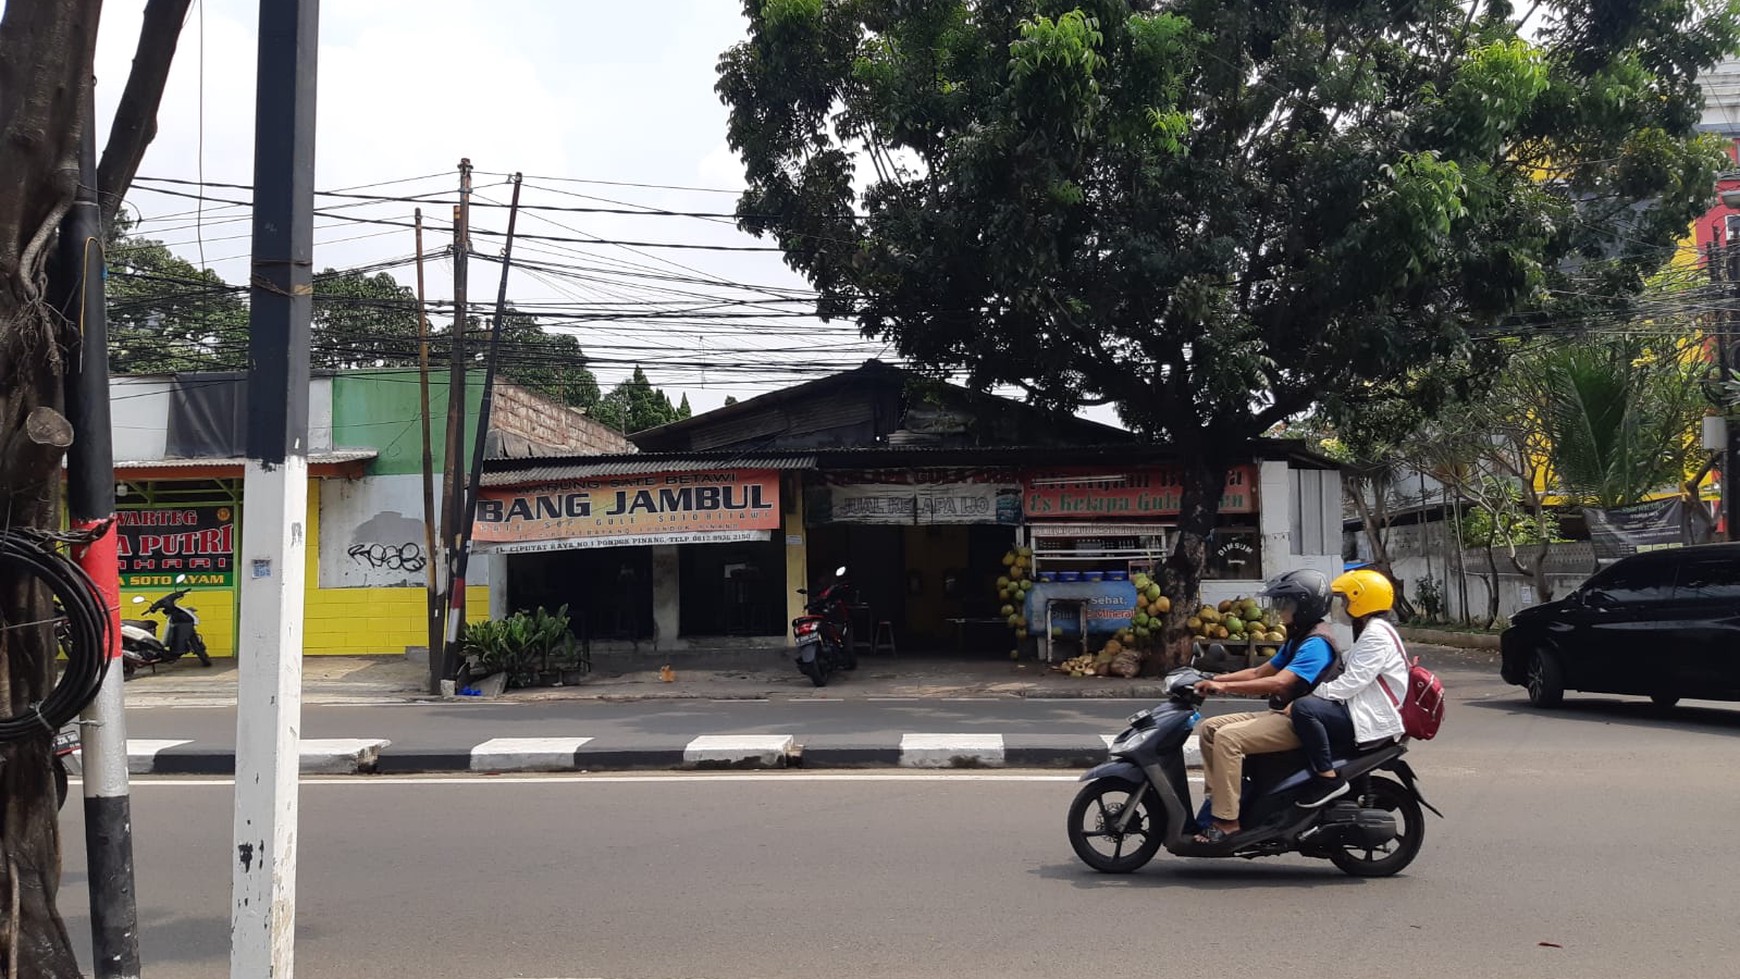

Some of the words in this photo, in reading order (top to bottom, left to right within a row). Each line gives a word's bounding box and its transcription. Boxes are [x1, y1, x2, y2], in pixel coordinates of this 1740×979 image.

[517, 480, 601, 494] WARUNG
[610, 477, 656, 488] SATE
[665, 473, 735, 485] BETAWI
[477, 493, 591, 523] BANG
[606, 485, 772, 516] JAMBUL
[843, 497, 885, 515] JUAL
[1060, 491, 1129, 514] Kelapa
[116, 510, 197, 526] WARTEG
[139, 523, 234, 556] PUTRI
[1217, 542, 1253, 557] DIMSUM
[130, 575, 172, 585] SOTO
